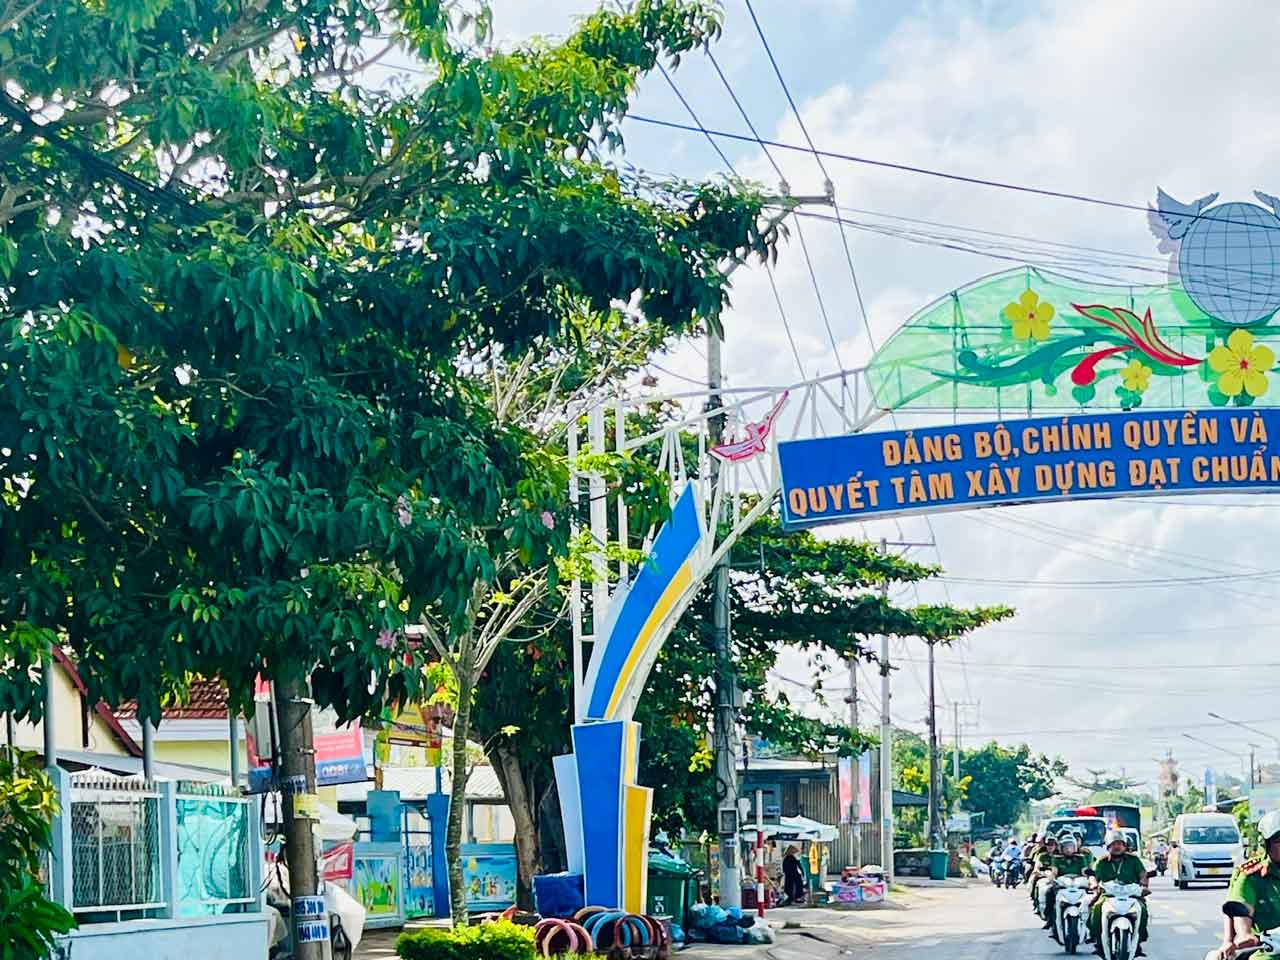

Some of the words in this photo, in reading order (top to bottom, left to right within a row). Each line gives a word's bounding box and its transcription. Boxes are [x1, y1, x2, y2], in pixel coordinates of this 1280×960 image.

[882, 430, 962, 467] ĐẢNG
[1123, 410, 1218, 450] QUYỀN
[1230, 411, 1268, 444] VÀ
[788, 471, 880, 517] QUYẾT
[891, 470, 954, 504] TÂM
[966, 463, 1021, 497] XÂY
[1035, 460, 1116, 495] DỰNG
[1130, 457, 1181, 489] ĐẠT
